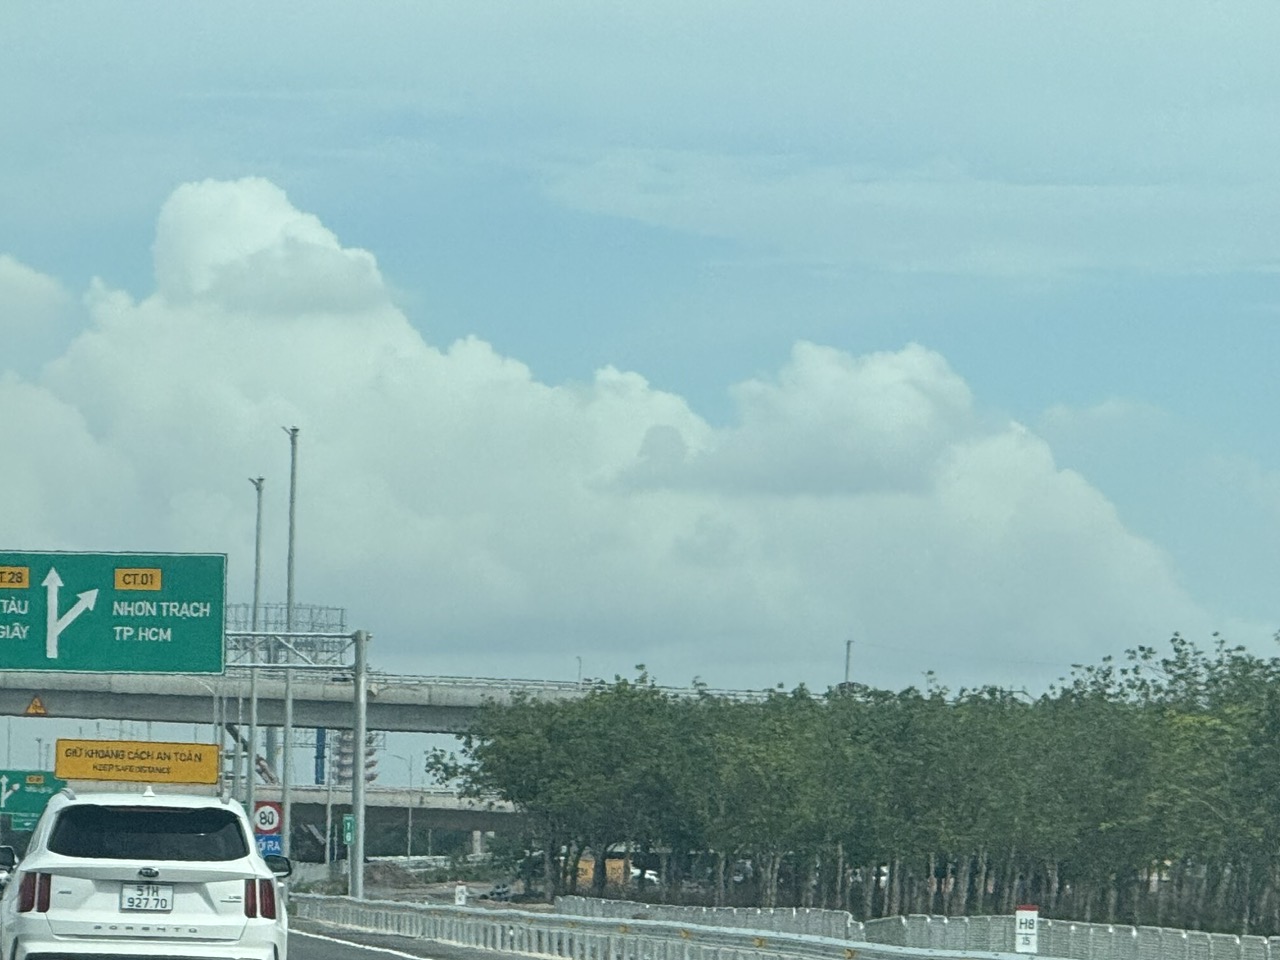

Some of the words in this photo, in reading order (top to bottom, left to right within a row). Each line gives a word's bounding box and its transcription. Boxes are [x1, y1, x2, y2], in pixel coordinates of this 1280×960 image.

[122, 573, 154, 586] CT.01
[0, 596, 29, 615] TÀU
[158, 602, 211, 620] TRẠCH
[156, 751, 172, 761] AN
[259, 811, 274, 826] 80
[267, 840, 281, 851] RA
[136, 885, 159, 897] 51H
[127, 897, 168, 909] 927.70
